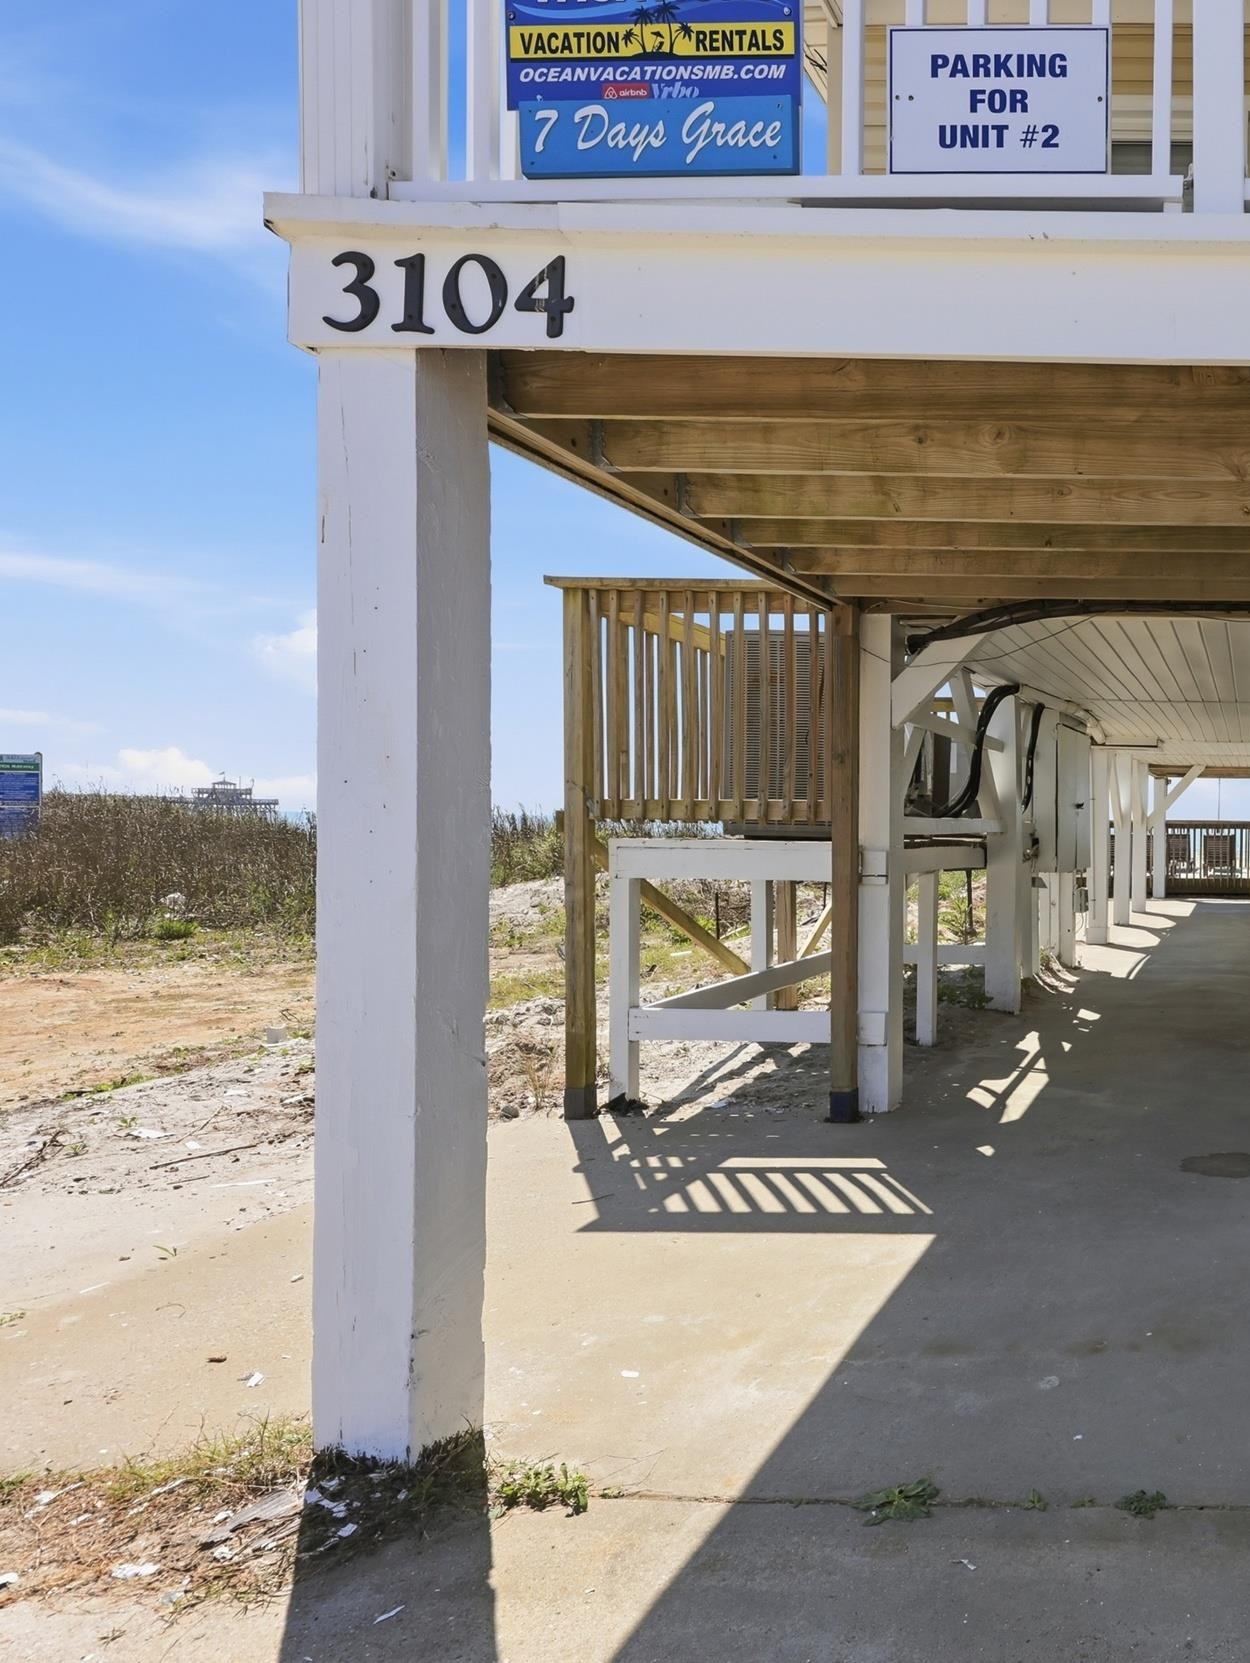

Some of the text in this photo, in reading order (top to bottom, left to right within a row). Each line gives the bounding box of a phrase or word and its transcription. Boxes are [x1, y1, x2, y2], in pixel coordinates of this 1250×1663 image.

[520, 29, 785, 55] VACATION RENTALS
[520, 64, 786, 82] OCEANVACATIONSMB.COM
[930, 53, 1068, 78] PARKING
[619, 88, 648, 97] airbnb
[651, 81, 699, 98] Vrbo
[969, 89, 1029, 113] FOR
[534, 101, 782, 164] 7 Days Grace
[938, 124, 1060, 149] UNIT #2
[322, 250, 575, 339] 3104
